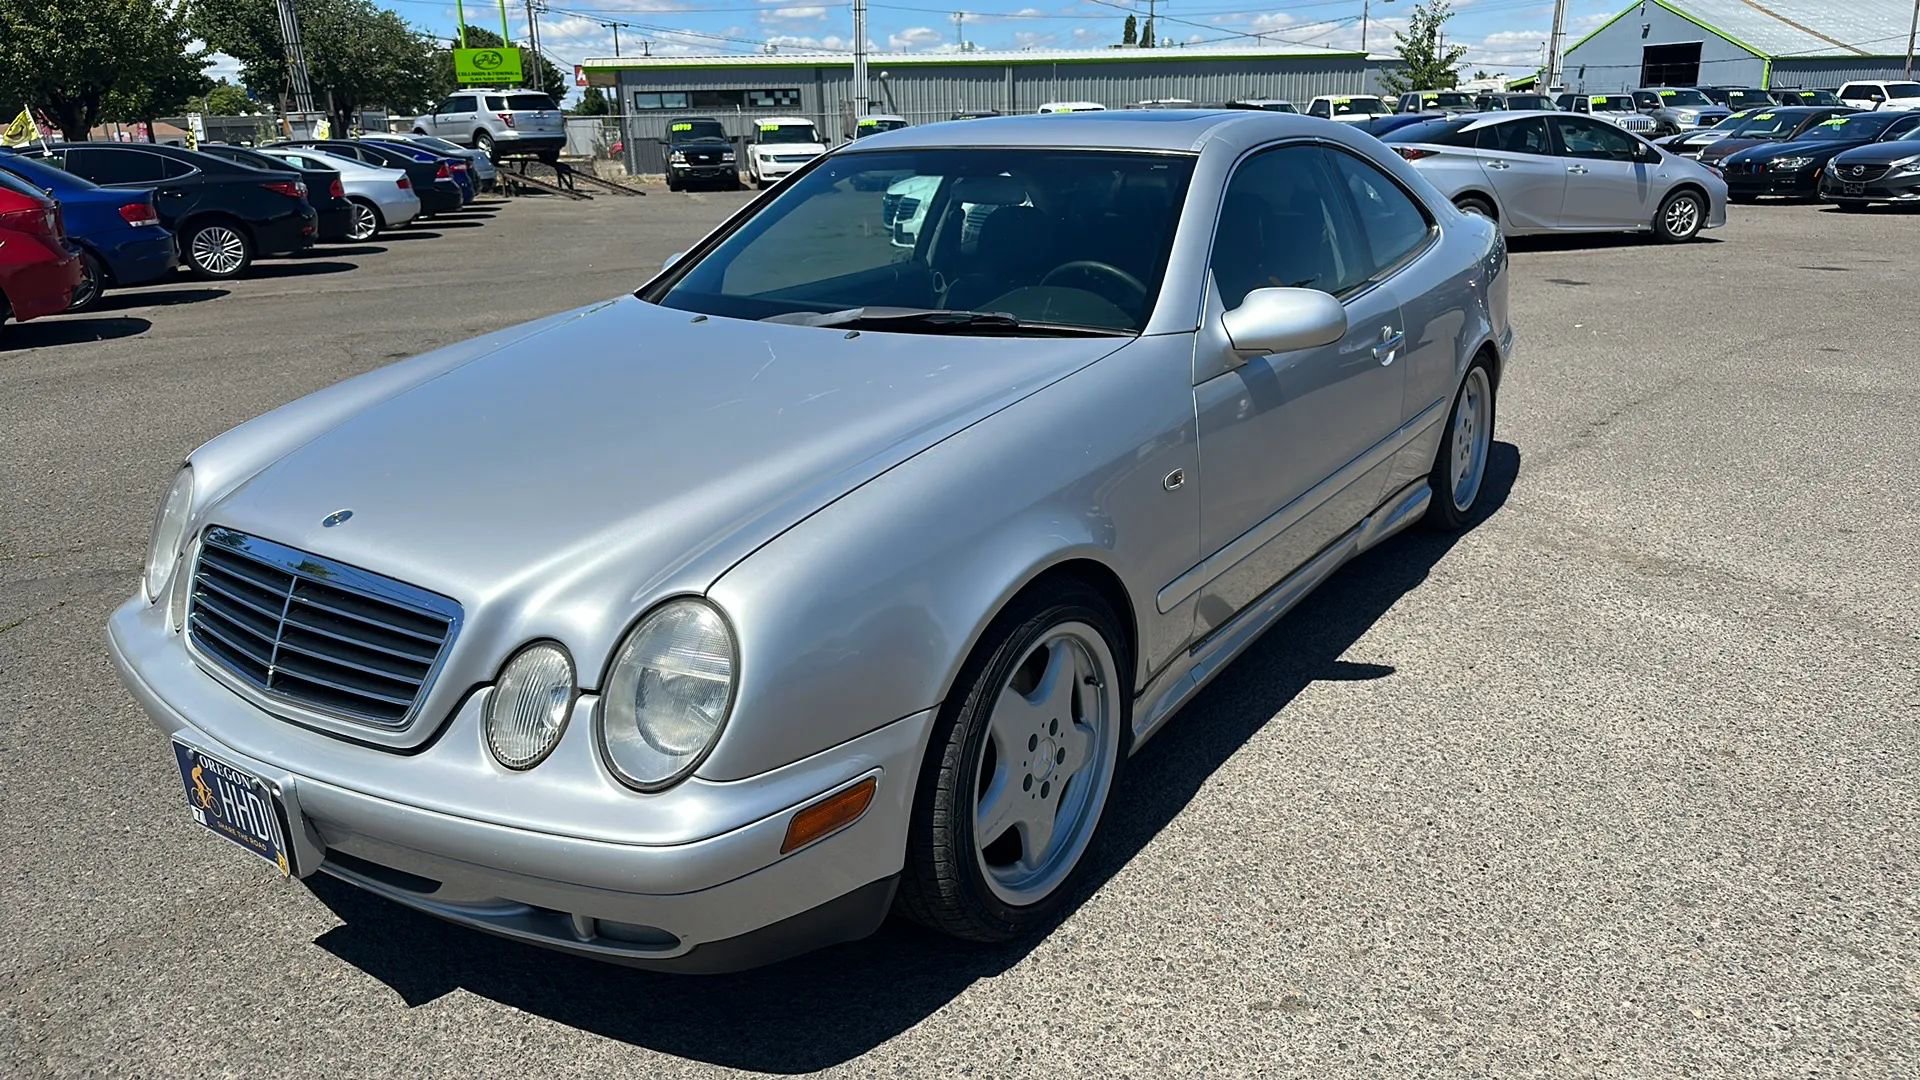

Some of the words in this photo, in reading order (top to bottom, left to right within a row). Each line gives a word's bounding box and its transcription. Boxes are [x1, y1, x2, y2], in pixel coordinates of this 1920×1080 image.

[199, 755, 251, 789] OREGON
[217, 821, 237, 836] SHARE
[236, 831, 249, 843] THE
[249, 837, 267, 851] ROAD
